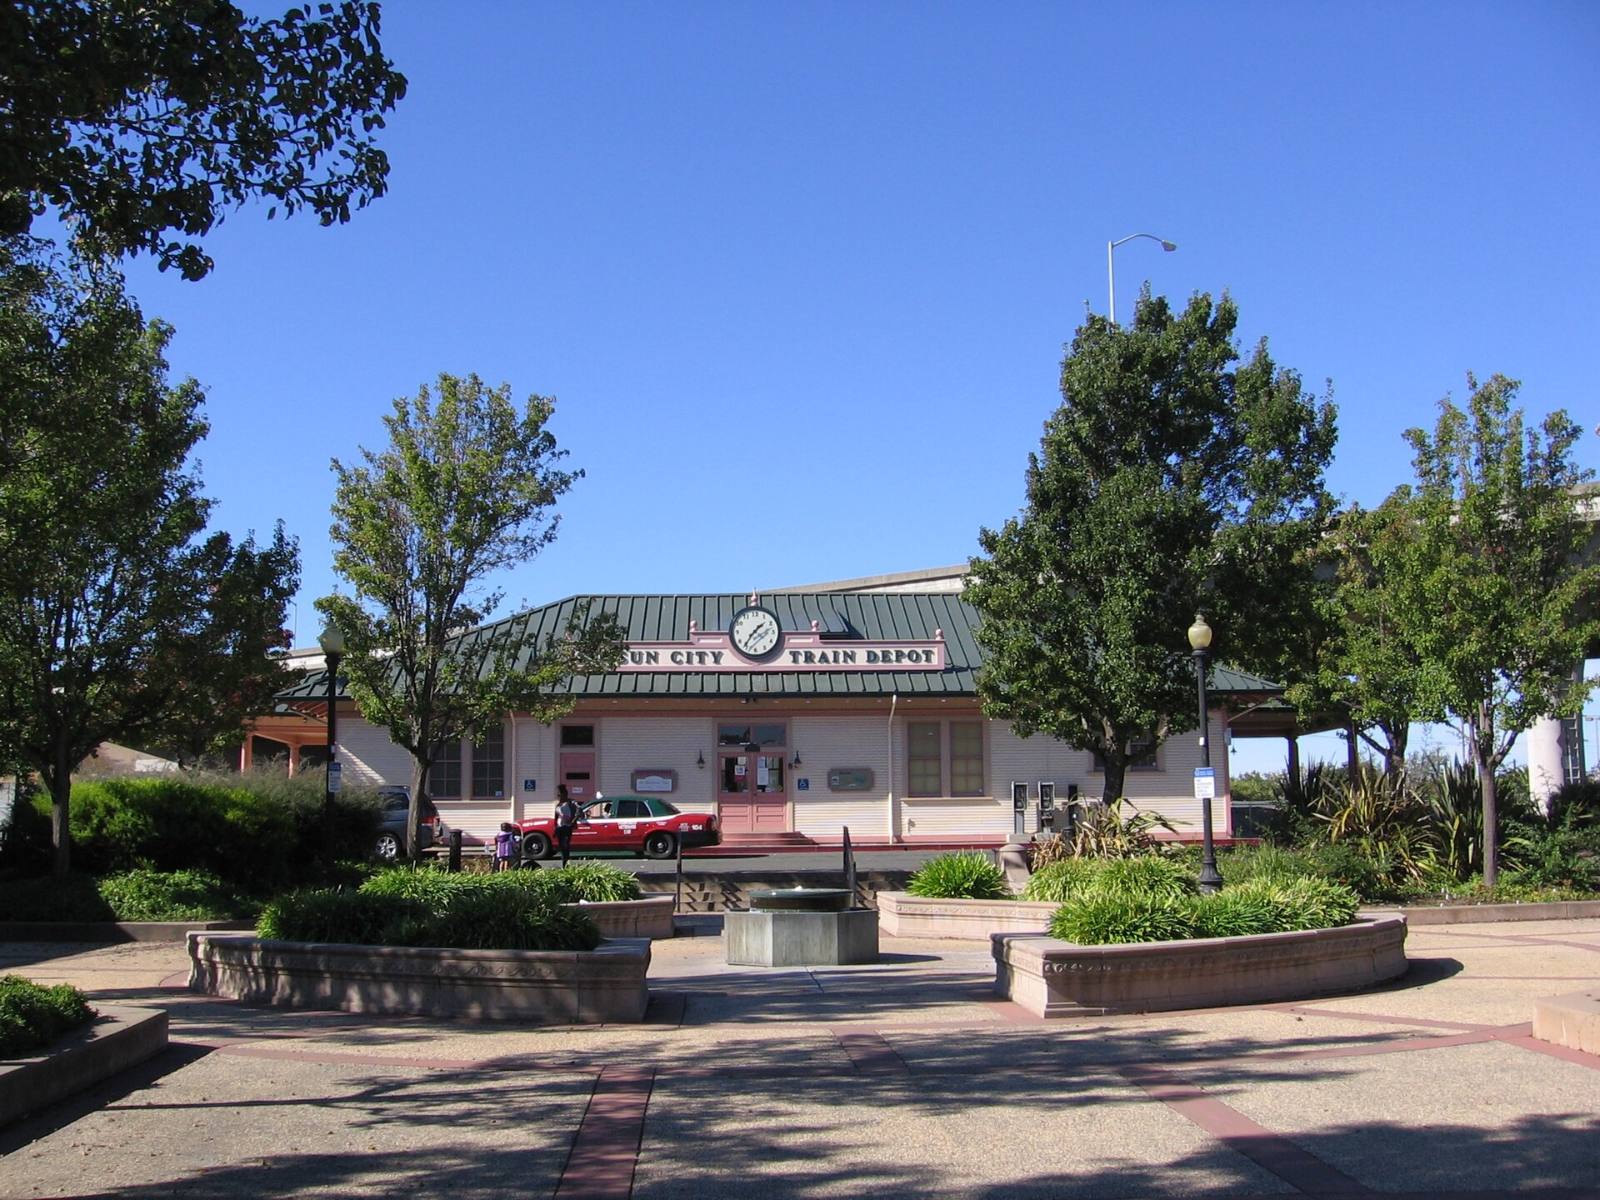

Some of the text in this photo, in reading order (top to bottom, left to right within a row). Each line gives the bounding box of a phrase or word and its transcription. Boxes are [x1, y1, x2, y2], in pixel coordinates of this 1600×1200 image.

[670, 651, 725, 665] CITY
[789, 650, 857, 665] TRAIN
[866, 649, 936, 664] DEPOT
